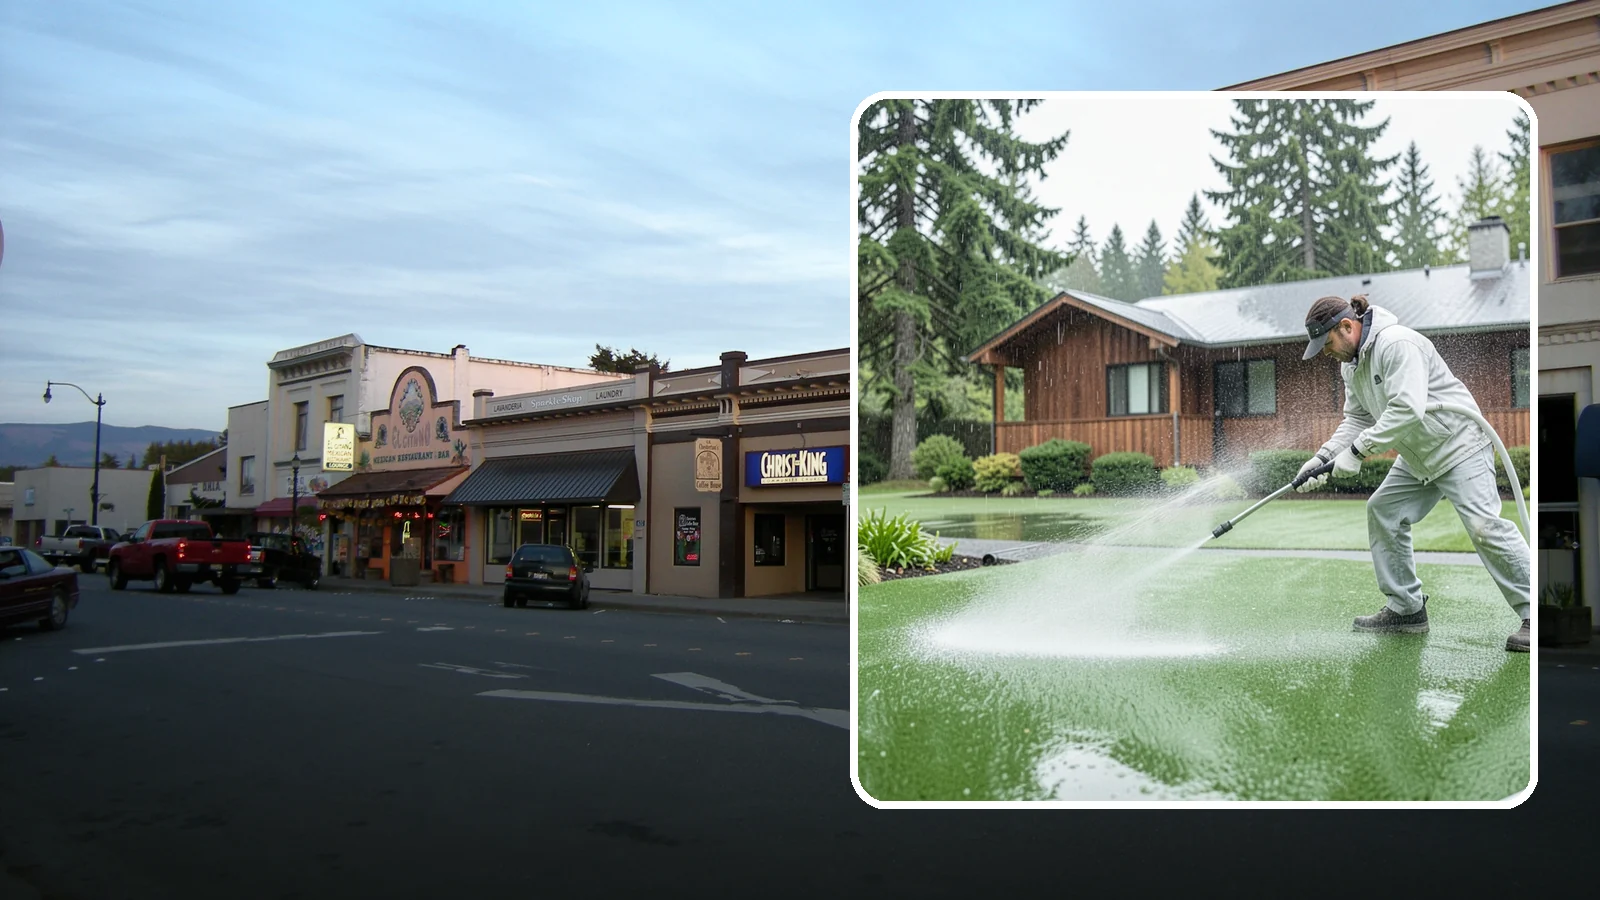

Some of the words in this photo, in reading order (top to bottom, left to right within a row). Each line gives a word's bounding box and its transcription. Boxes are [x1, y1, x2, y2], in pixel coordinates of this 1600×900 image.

[595, 389, 623, 400] LAUNDRY
[493, 402, 523, 413] LAVANDERIA
[530, 397, 561, 409] Sparkle
[562, 394, 583, 405] Shop
[373, 455, 396, 465] MEXICAN
[397, 451, 433, 462] RESTAURANT
[438, 450, 450, 459] BAR
[761, 452, 797, 478] CHRIST
[799, 450, 827, 476] KING
[696, 481, 709, 489] Coffee
[710, 481, 722, 489] House
